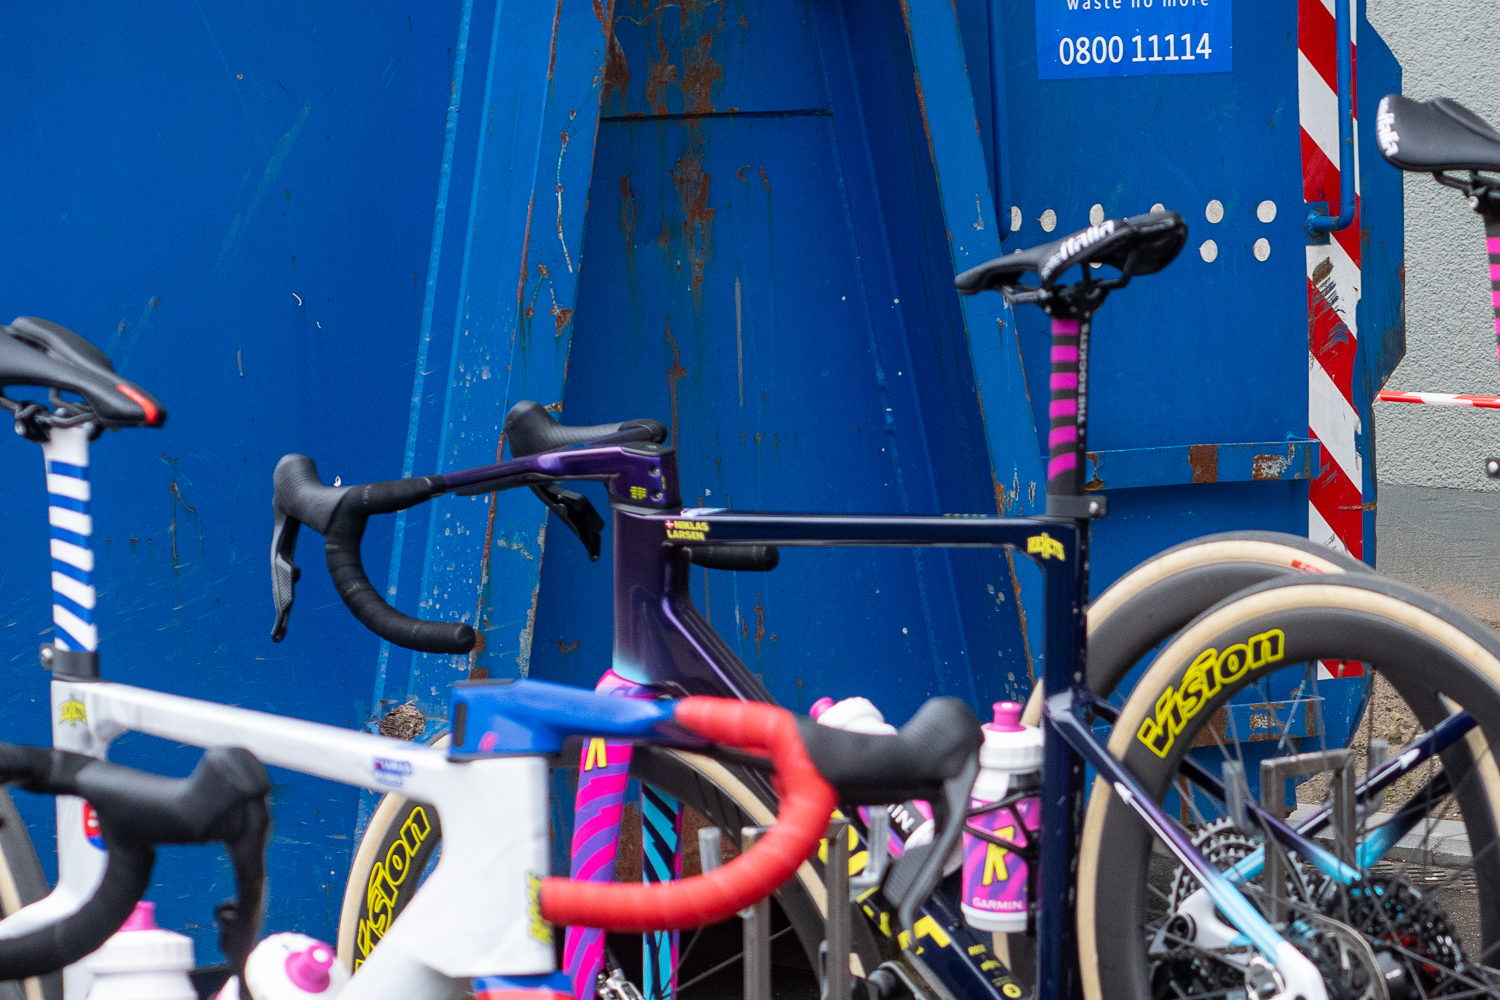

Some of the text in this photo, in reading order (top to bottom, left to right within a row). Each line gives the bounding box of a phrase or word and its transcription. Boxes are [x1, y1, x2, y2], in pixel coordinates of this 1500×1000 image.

[1059, 32, 1212, 65] 0800 11114
[1060, 220, 1115, 261] italia
[666, 529, 706, 541] LARSEN
[674, 520, 710, 532] NIKLAS
[1136, 628, 1286, 760] Vision
[972, 897, 1024, 911] GARMIN
